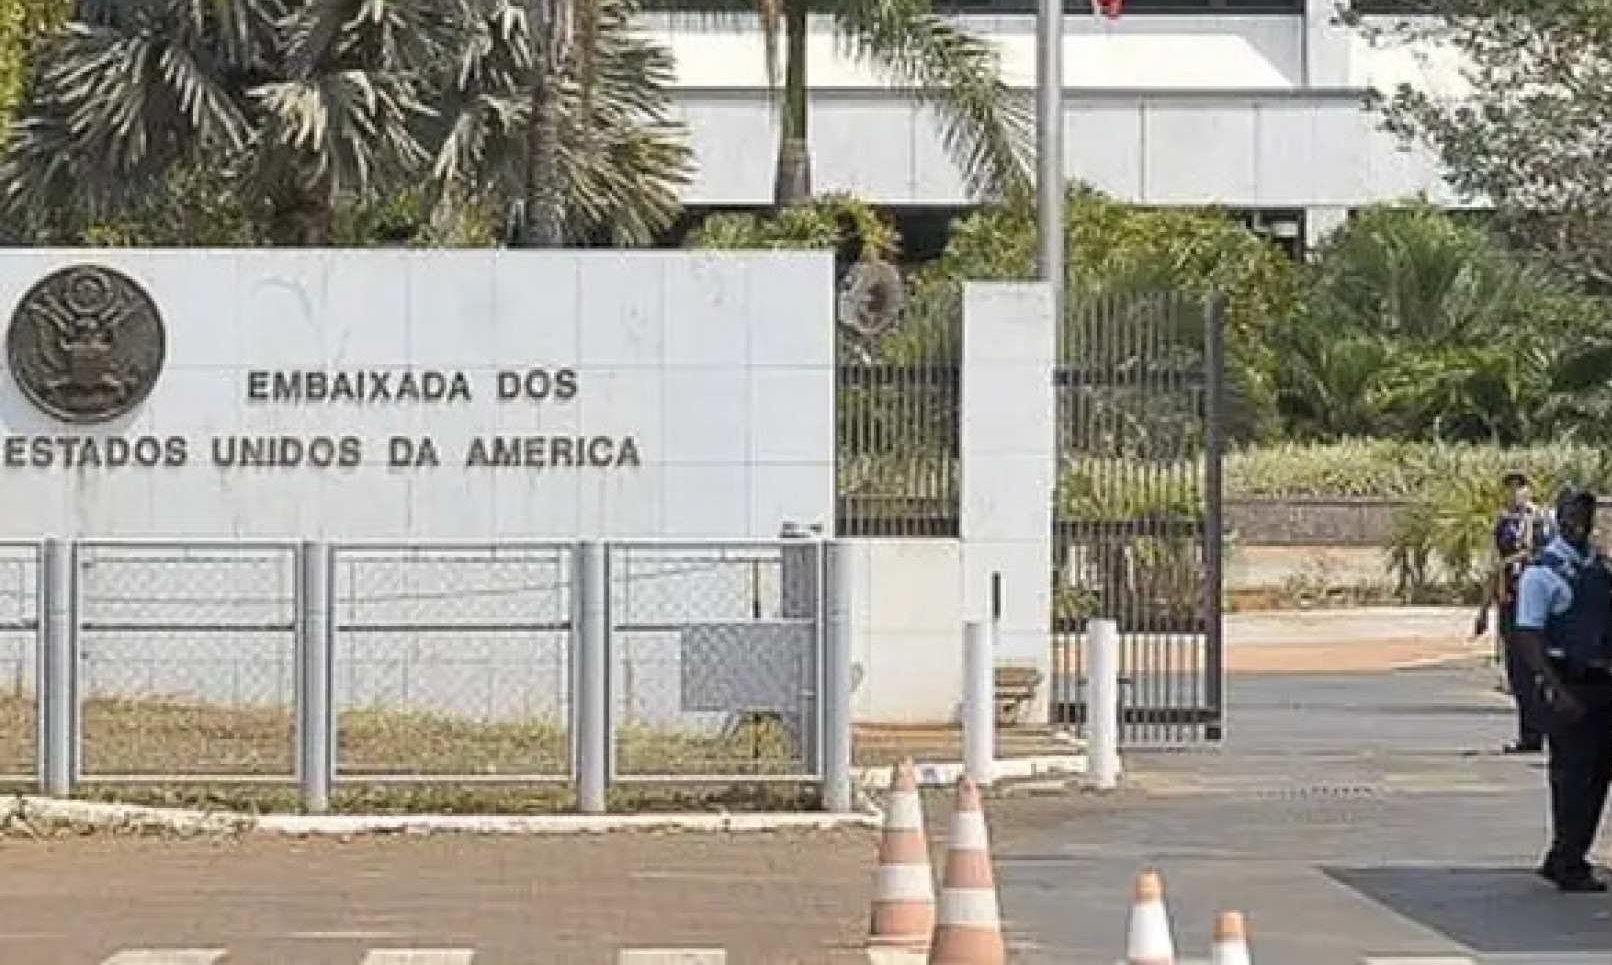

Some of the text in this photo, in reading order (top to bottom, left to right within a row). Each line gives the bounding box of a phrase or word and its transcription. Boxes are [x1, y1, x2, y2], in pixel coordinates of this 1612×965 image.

[247, 370, 578, 401] EMBAIXADA DOS
[5, 436, 641, 467] ESTADOS UNIDOS DA AMERICA
